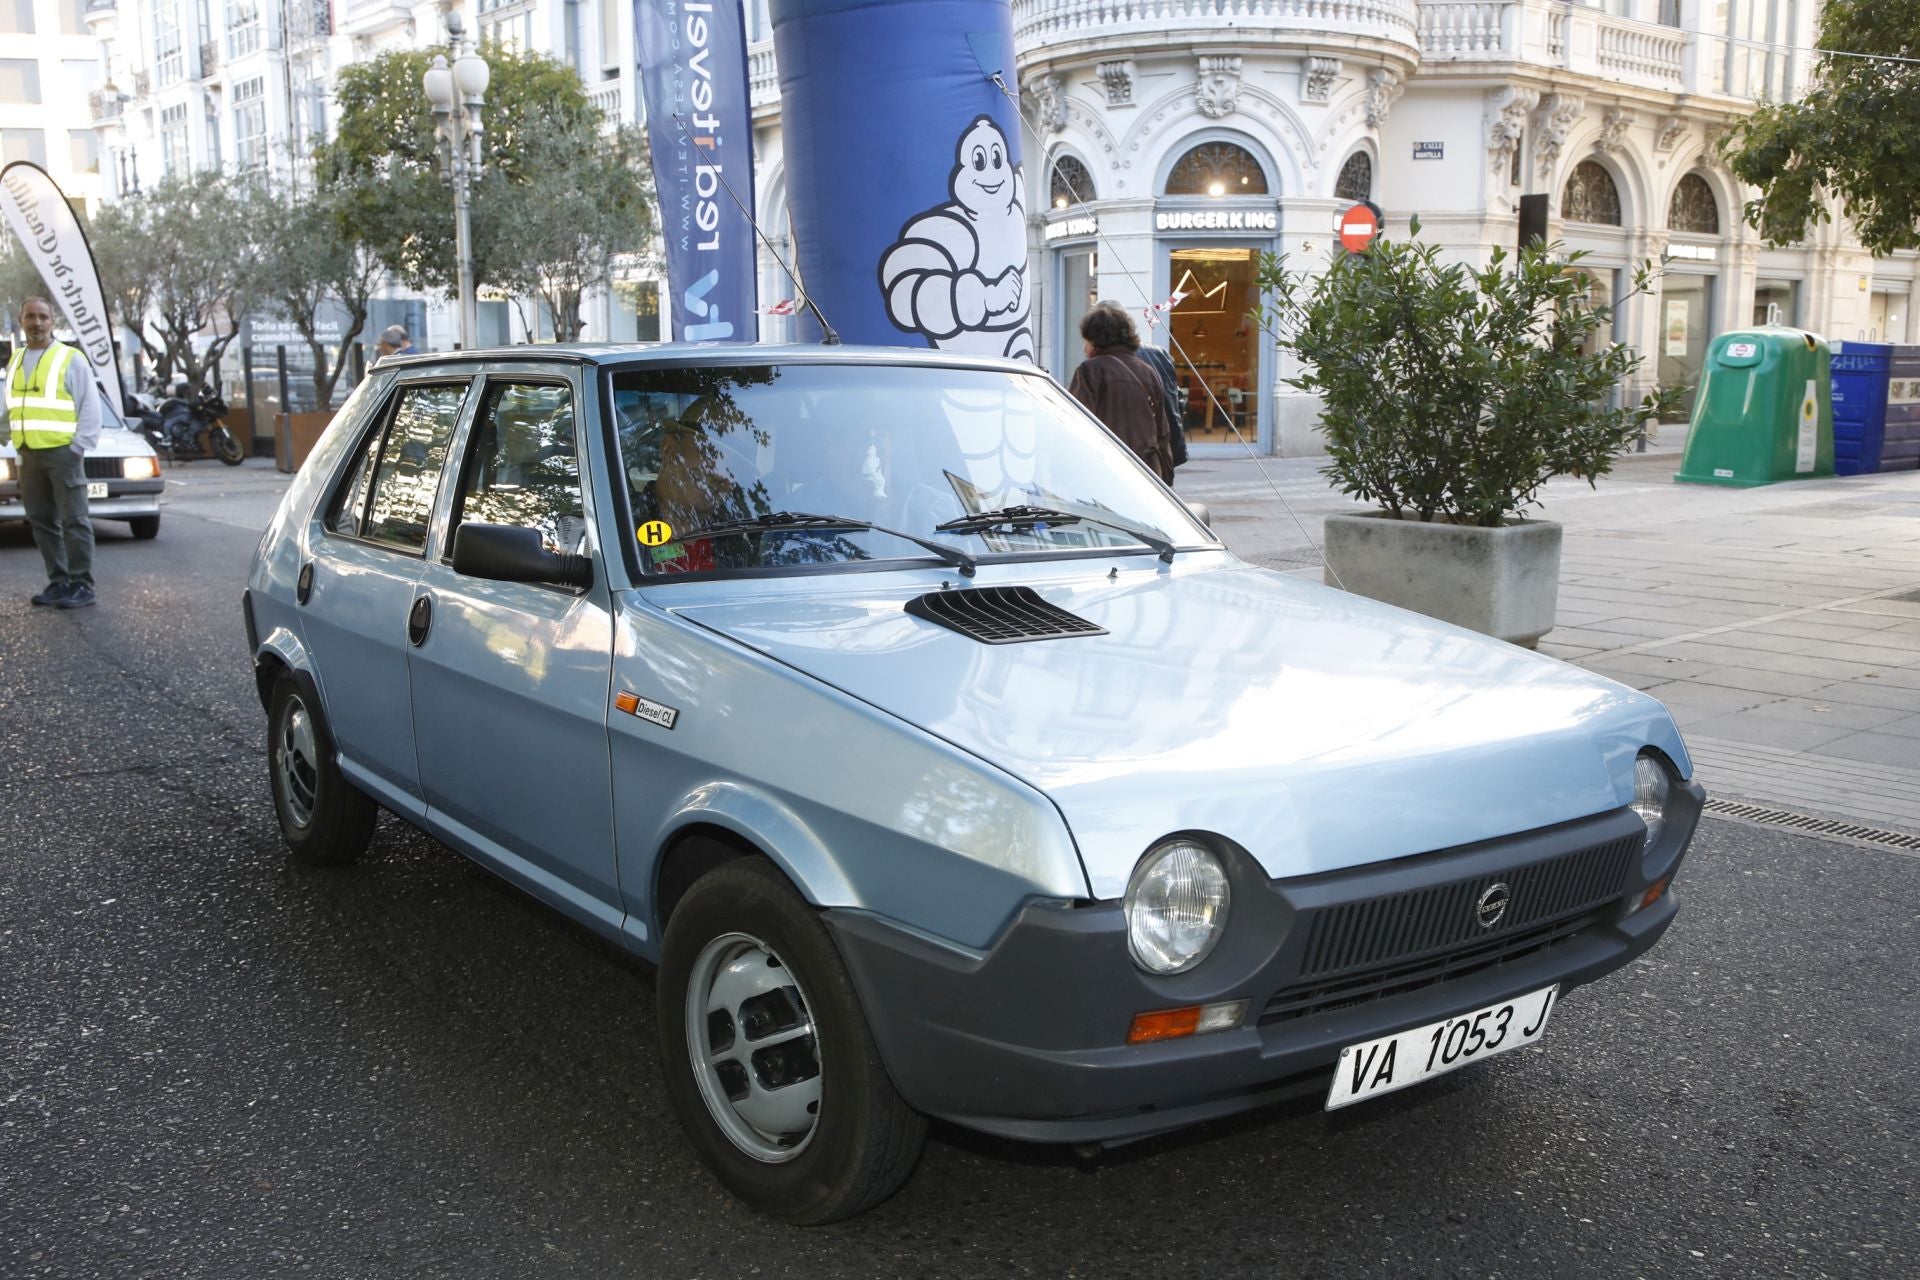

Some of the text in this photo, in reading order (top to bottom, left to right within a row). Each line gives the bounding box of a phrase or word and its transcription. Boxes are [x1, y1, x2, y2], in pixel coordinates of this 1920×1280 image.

[1156, 211, 1277, 230] BURGER KING
[250, 320, 276, 331] Todo
[251, 332, 290, 342] cuando
[646, 523, 663, 544] H
[638, 702, 672, 724] Diesel CL
[1351, 990, 1553, 1094] VA 1053 J
